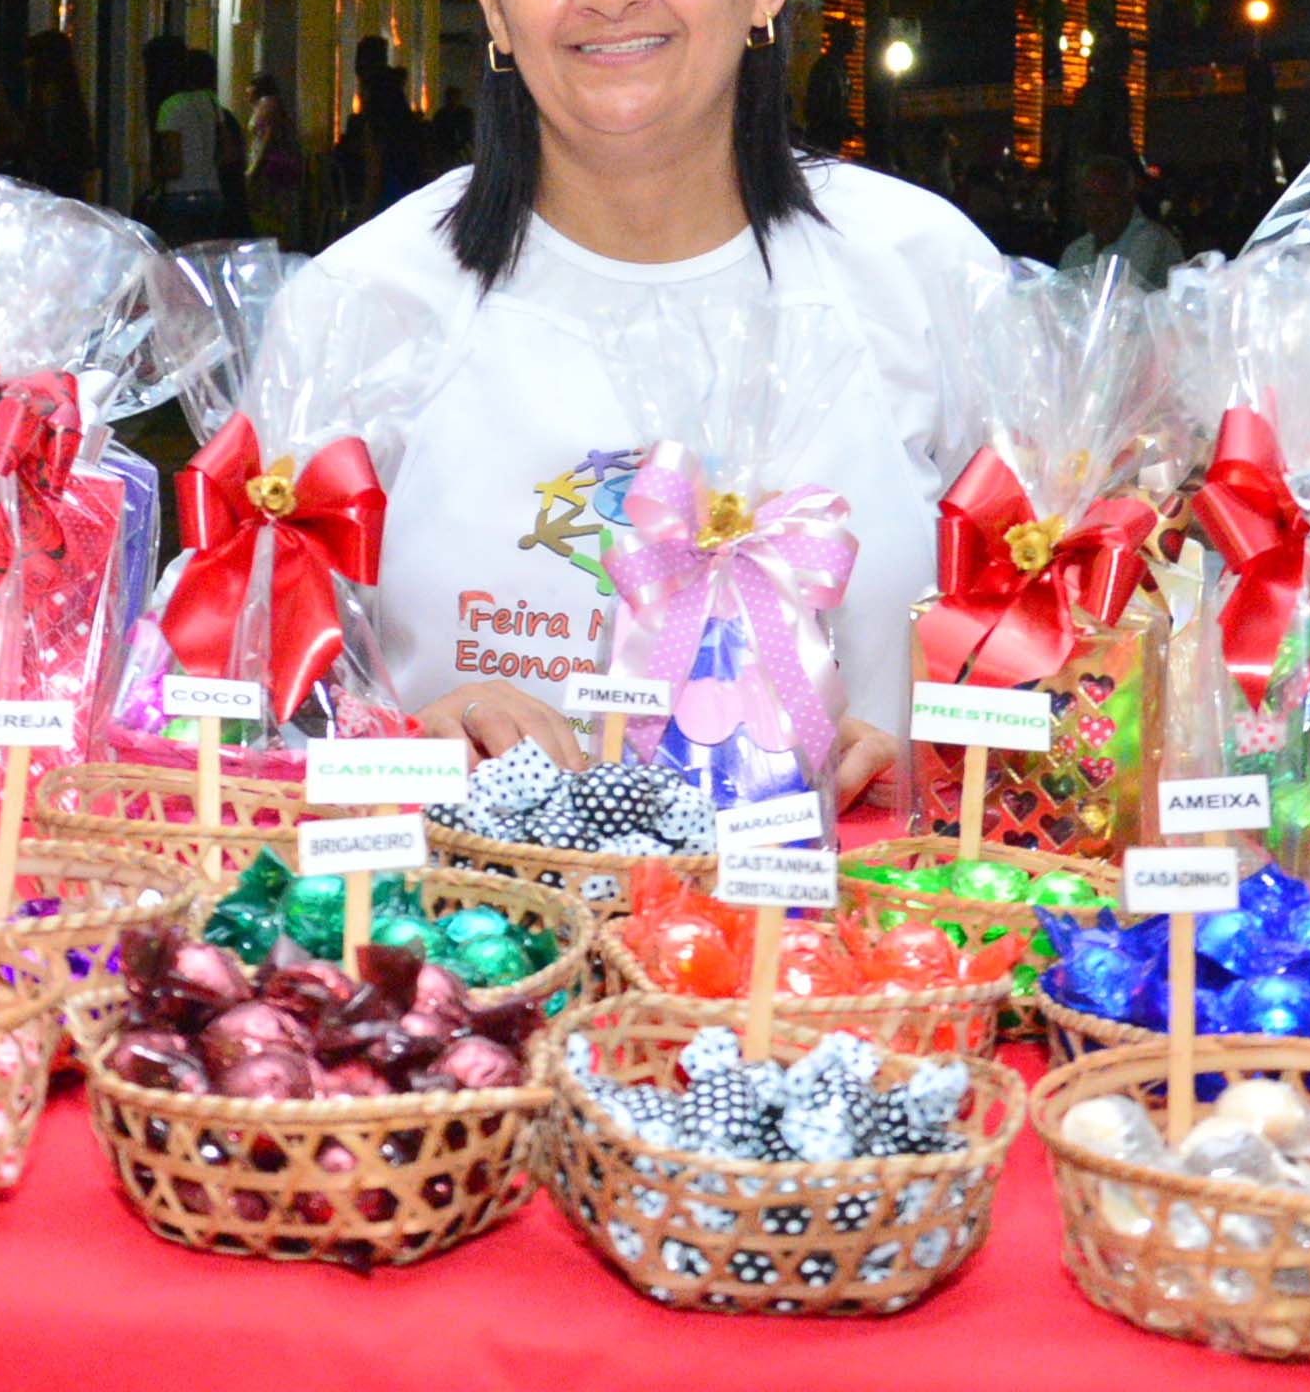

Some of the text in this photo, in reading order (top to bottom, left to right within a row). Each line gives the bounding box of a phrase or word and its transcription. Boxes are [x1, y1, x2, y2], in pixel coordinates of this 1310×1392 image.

[458, 590, 570, 639] Feira
[170, 689, 252, 706] COCO
[914, 702, 1047, 729] PRESTIGIO
[318, 763, 463, 777] CASTANHA
[1168, 792, 1261, 811] AMEIXA
[309, 831, 415, 857] BRIGADEIRO
[1133, 869, 1231, 888] CASADINHO
[725, 879, 830, 901] CRISTALIZADA
